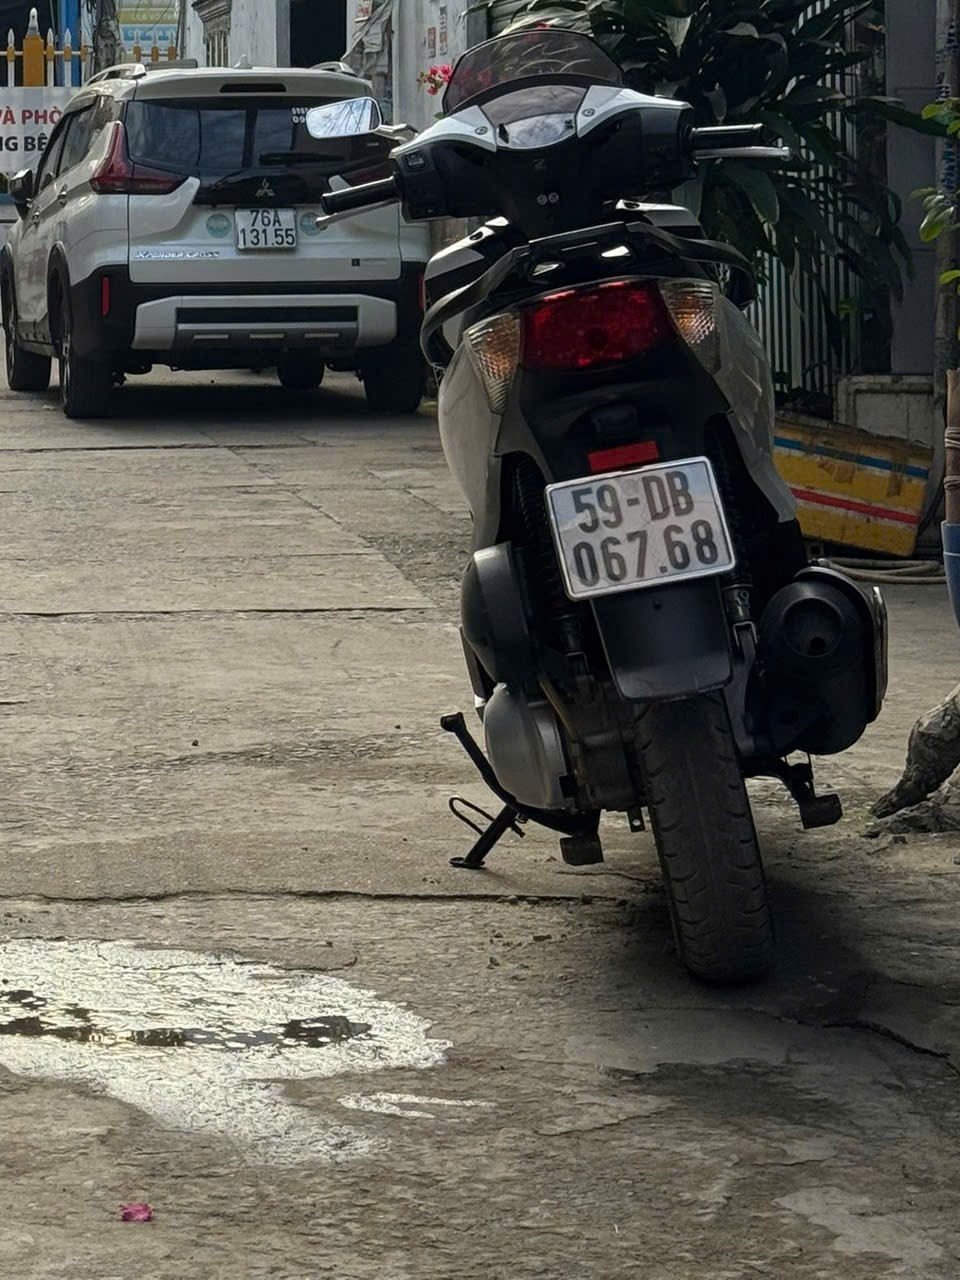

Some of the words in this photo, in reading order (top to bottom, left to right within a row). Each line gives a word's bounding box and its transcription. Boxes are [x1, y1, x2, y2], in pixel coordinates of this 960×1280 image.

[21, 106, 62, 125] PHÒ
[24, 133, 48, 152] BÊ
[250, 210, 282, 227] 76A
[240, 228, 295, 246] 131.55
[571, 470, 695, 534] 59-DB
[572, 519, 719, 587] 067.68
